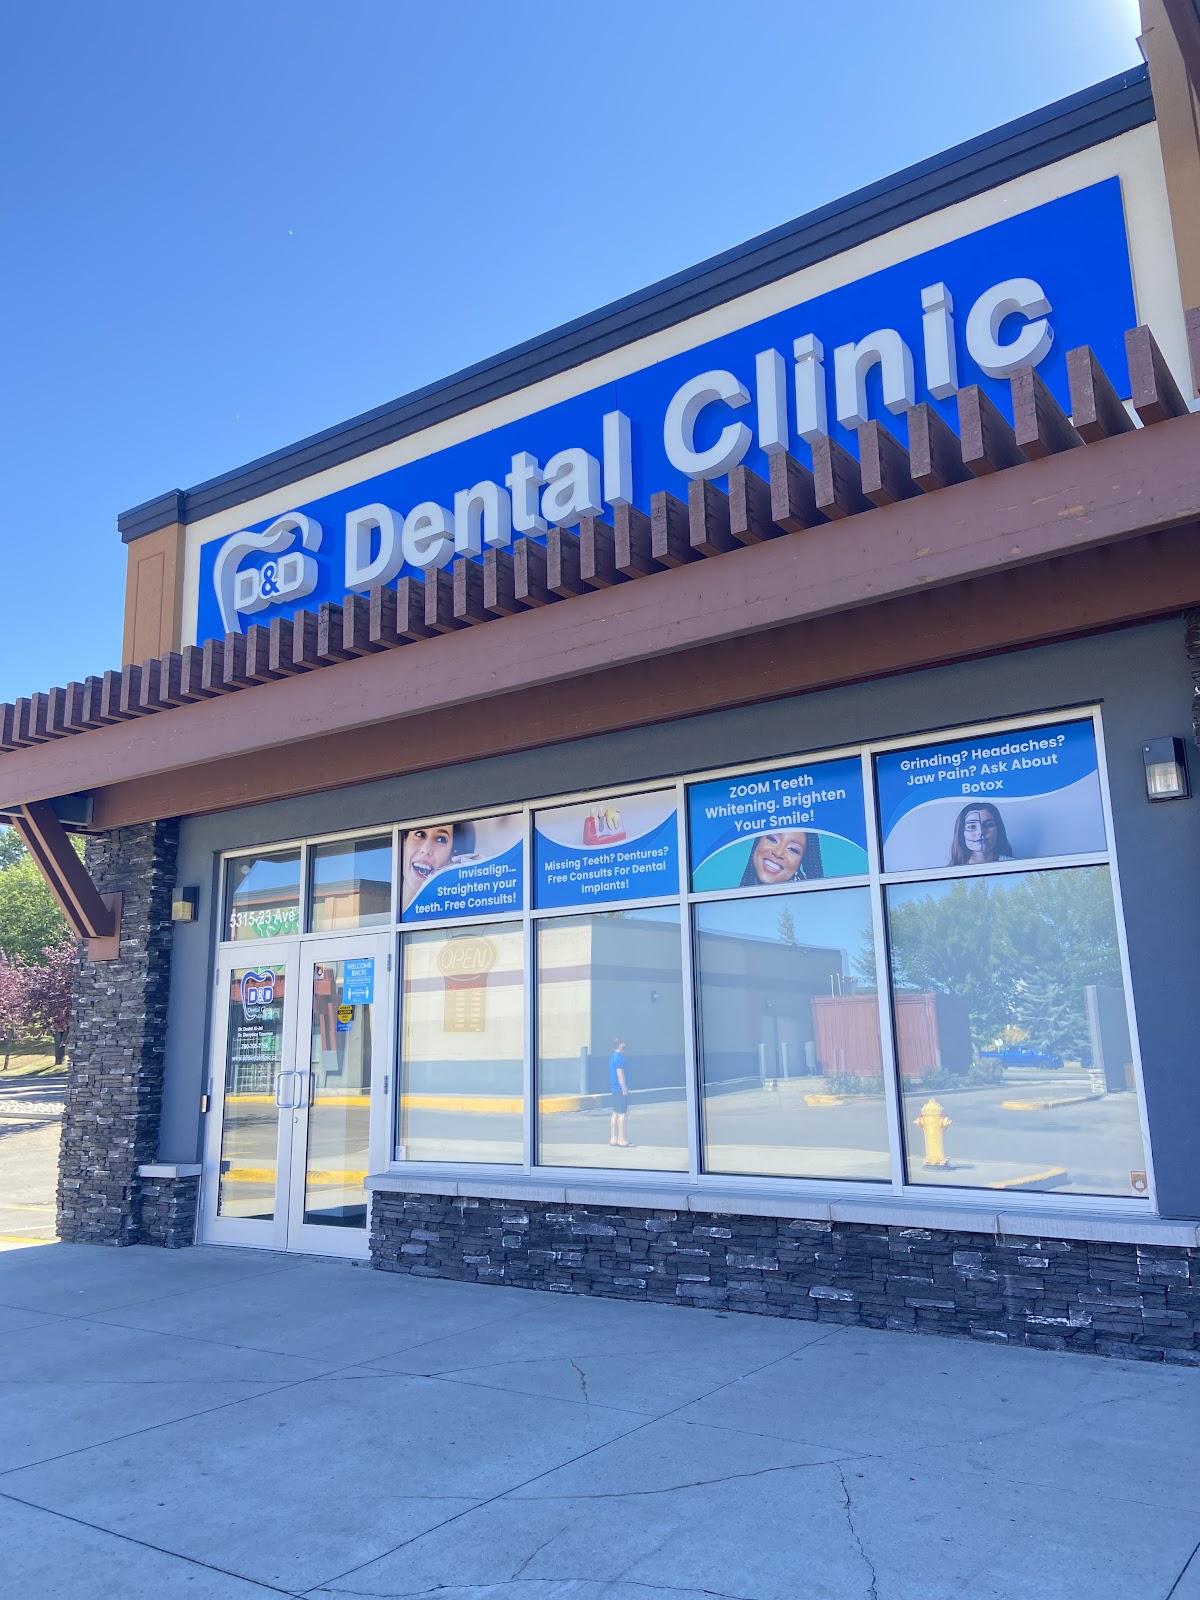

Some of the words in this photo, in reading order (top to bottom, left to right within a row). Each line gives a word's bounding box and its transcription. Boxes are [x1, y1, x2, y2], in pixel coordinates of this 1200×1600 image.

[344, 410, 632, 593] Dental
[662, 277, 1053, 481] Clinic
[234, 552, 318, 614] D&D
[899, 751, 968, 772] Grinding?
[971, 735, 1065, 760] Headaches?
[906, 771, 935, 787] Jaw
[937, 765, 977, 783] Pain?
[980, 760, 1009, 775] Ask
[1011, 753, 1059, 770] About
[729, 781, 770, 798] ZOOM
[773, 774, 814, 790] Teeth
[961, 778, 1004, 795] Botox
[705, 798, 780, 821] Whitening.
[783, 787, 846, 810] Brighten
[734, 817, 767, 833] Your
[769, 810, 815, 827] Smile!
[544, 857, 581, 873] Missing
[582, 852, 615, 867] Teeth?
[617, 846, 669, 862] Dentures?
[547, 873, 568, 885] Free
[569, 868, 613, 883] Consults
[614, 865, 631, 877] For
[632, 860, 666, 874] Dental
[437, 883, 490, 897] Straighten
[492, 877, 517, 893] your
[581, 880, 630, 895] Implants!
[415, 902, 443, 915] teeth.
[444, 900, 466, 912] Free
[467, 893, 517, 910] Consults!
[274, 908, 295, 923] Ave
[346, 962, 372, 970] WELCOME
[441, 947, 488, 969] OPEN
[351, 969, 366, 977] BACK!
[247, 985, 274, 1005] D&D
